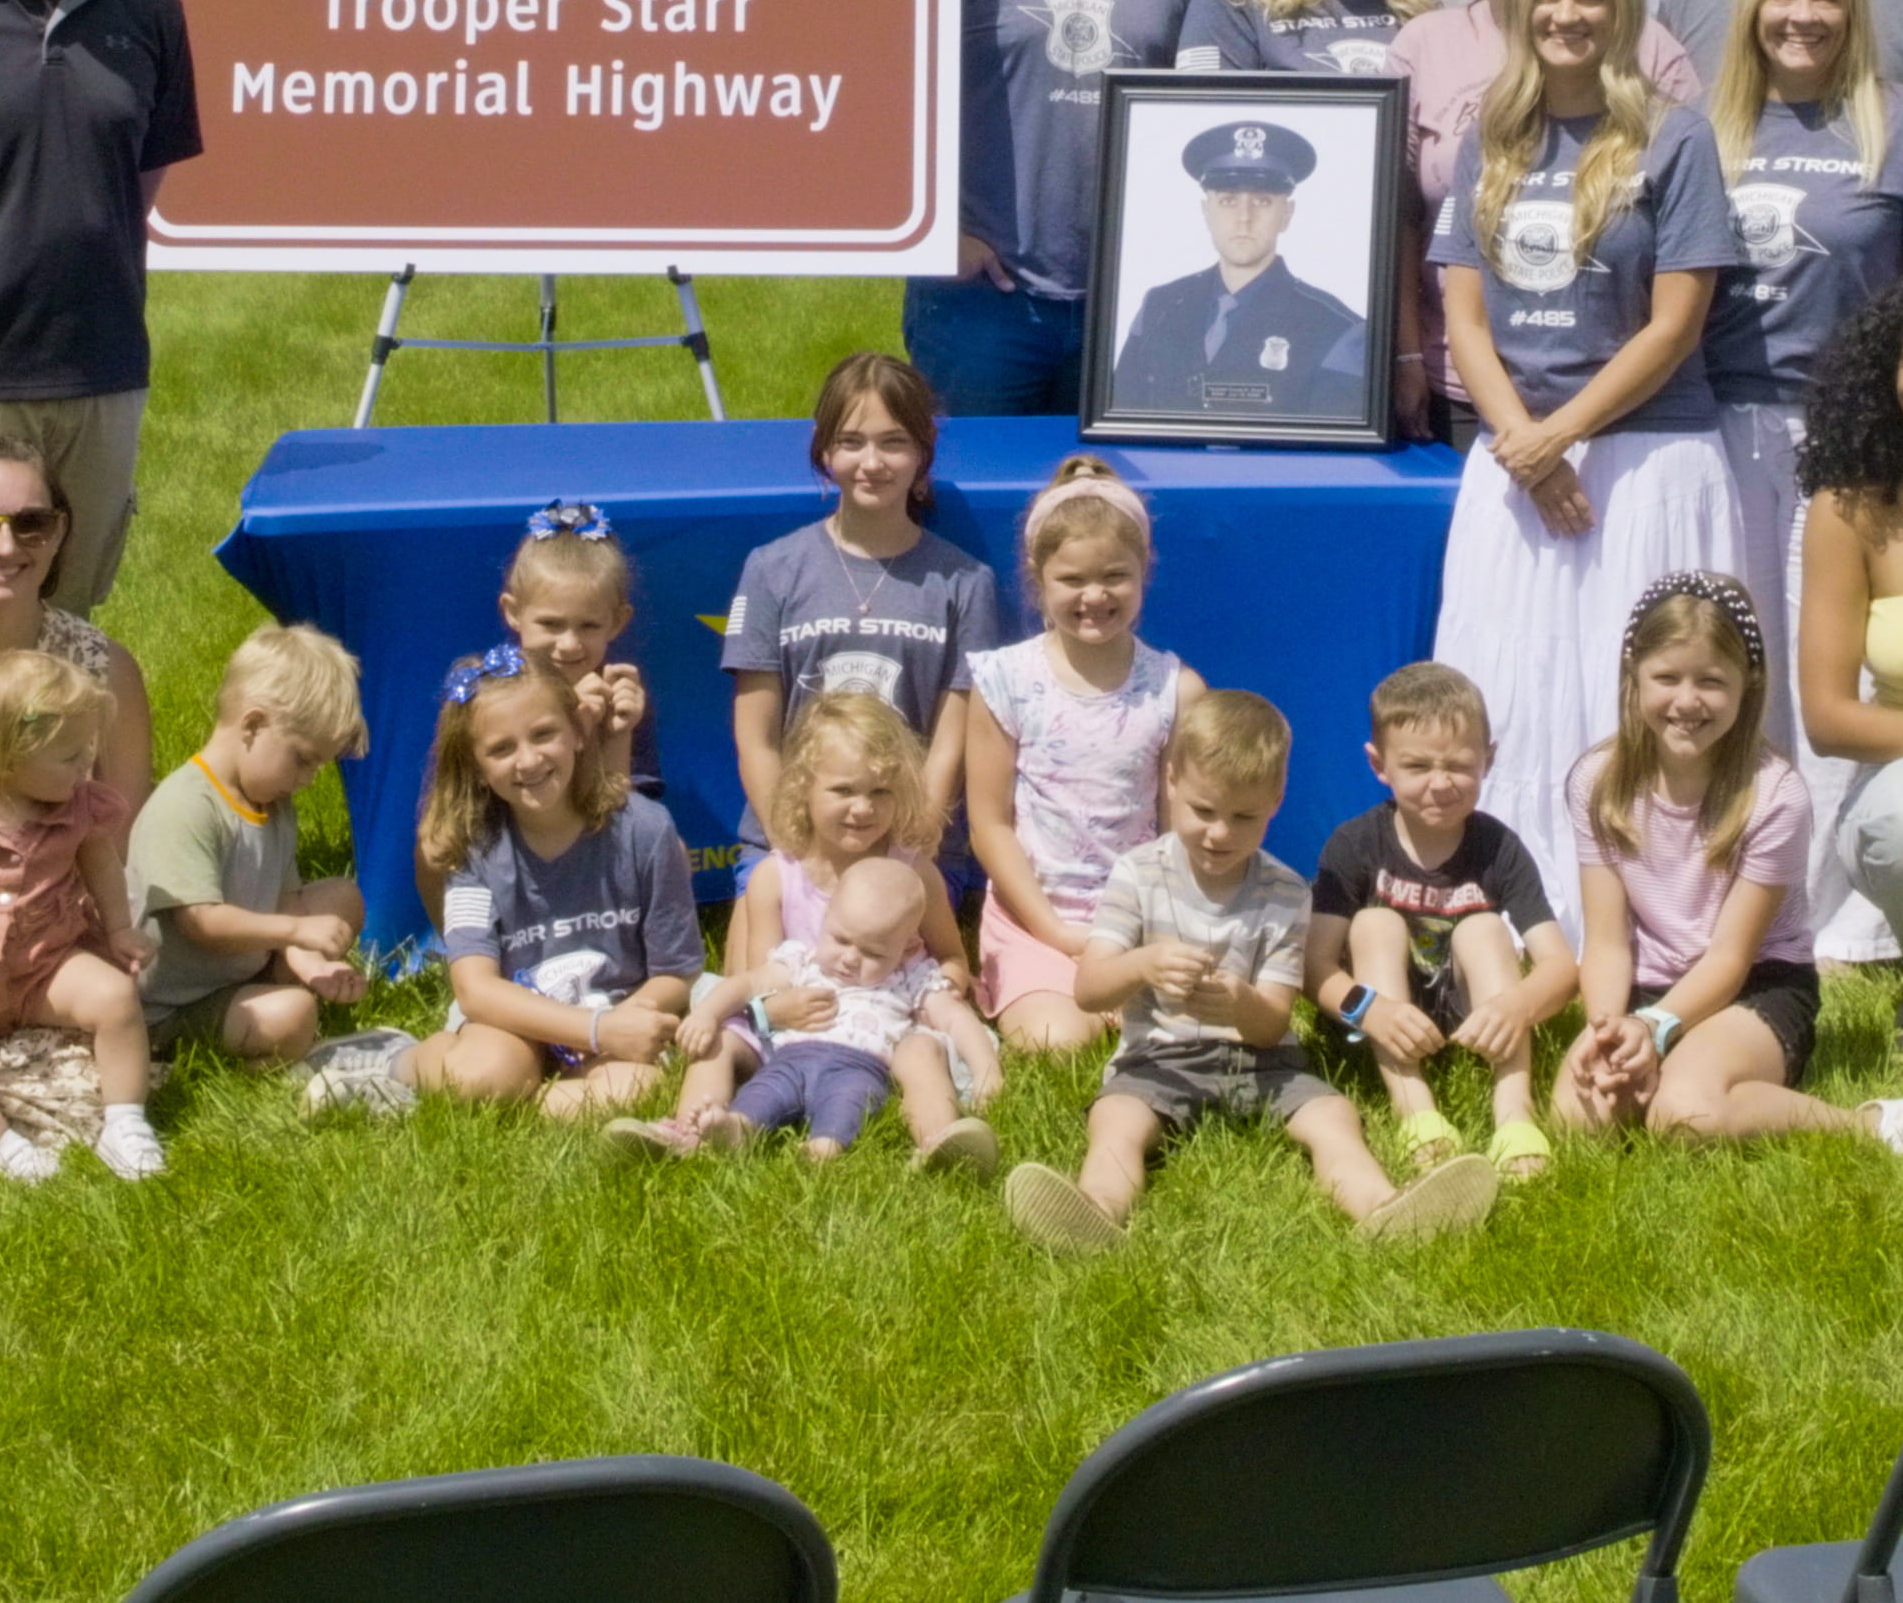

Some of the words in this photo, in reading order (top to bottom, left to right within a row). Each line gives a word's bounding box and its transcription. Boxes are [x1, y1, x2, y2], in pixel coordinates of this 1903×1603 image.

[1270, 16, 1338, 33] STARR
[1341, 14, 1396, 29] STRO
[231, 58, 533, 116] Memorial
[566, 59, 842, 131] Highway
[1509, 310, 1576, 327] #485
[779, 617, 852, 646] STARR
[858, 617, 947, 644] STRON
[826, 662, 892, 682] MICHIGAN
